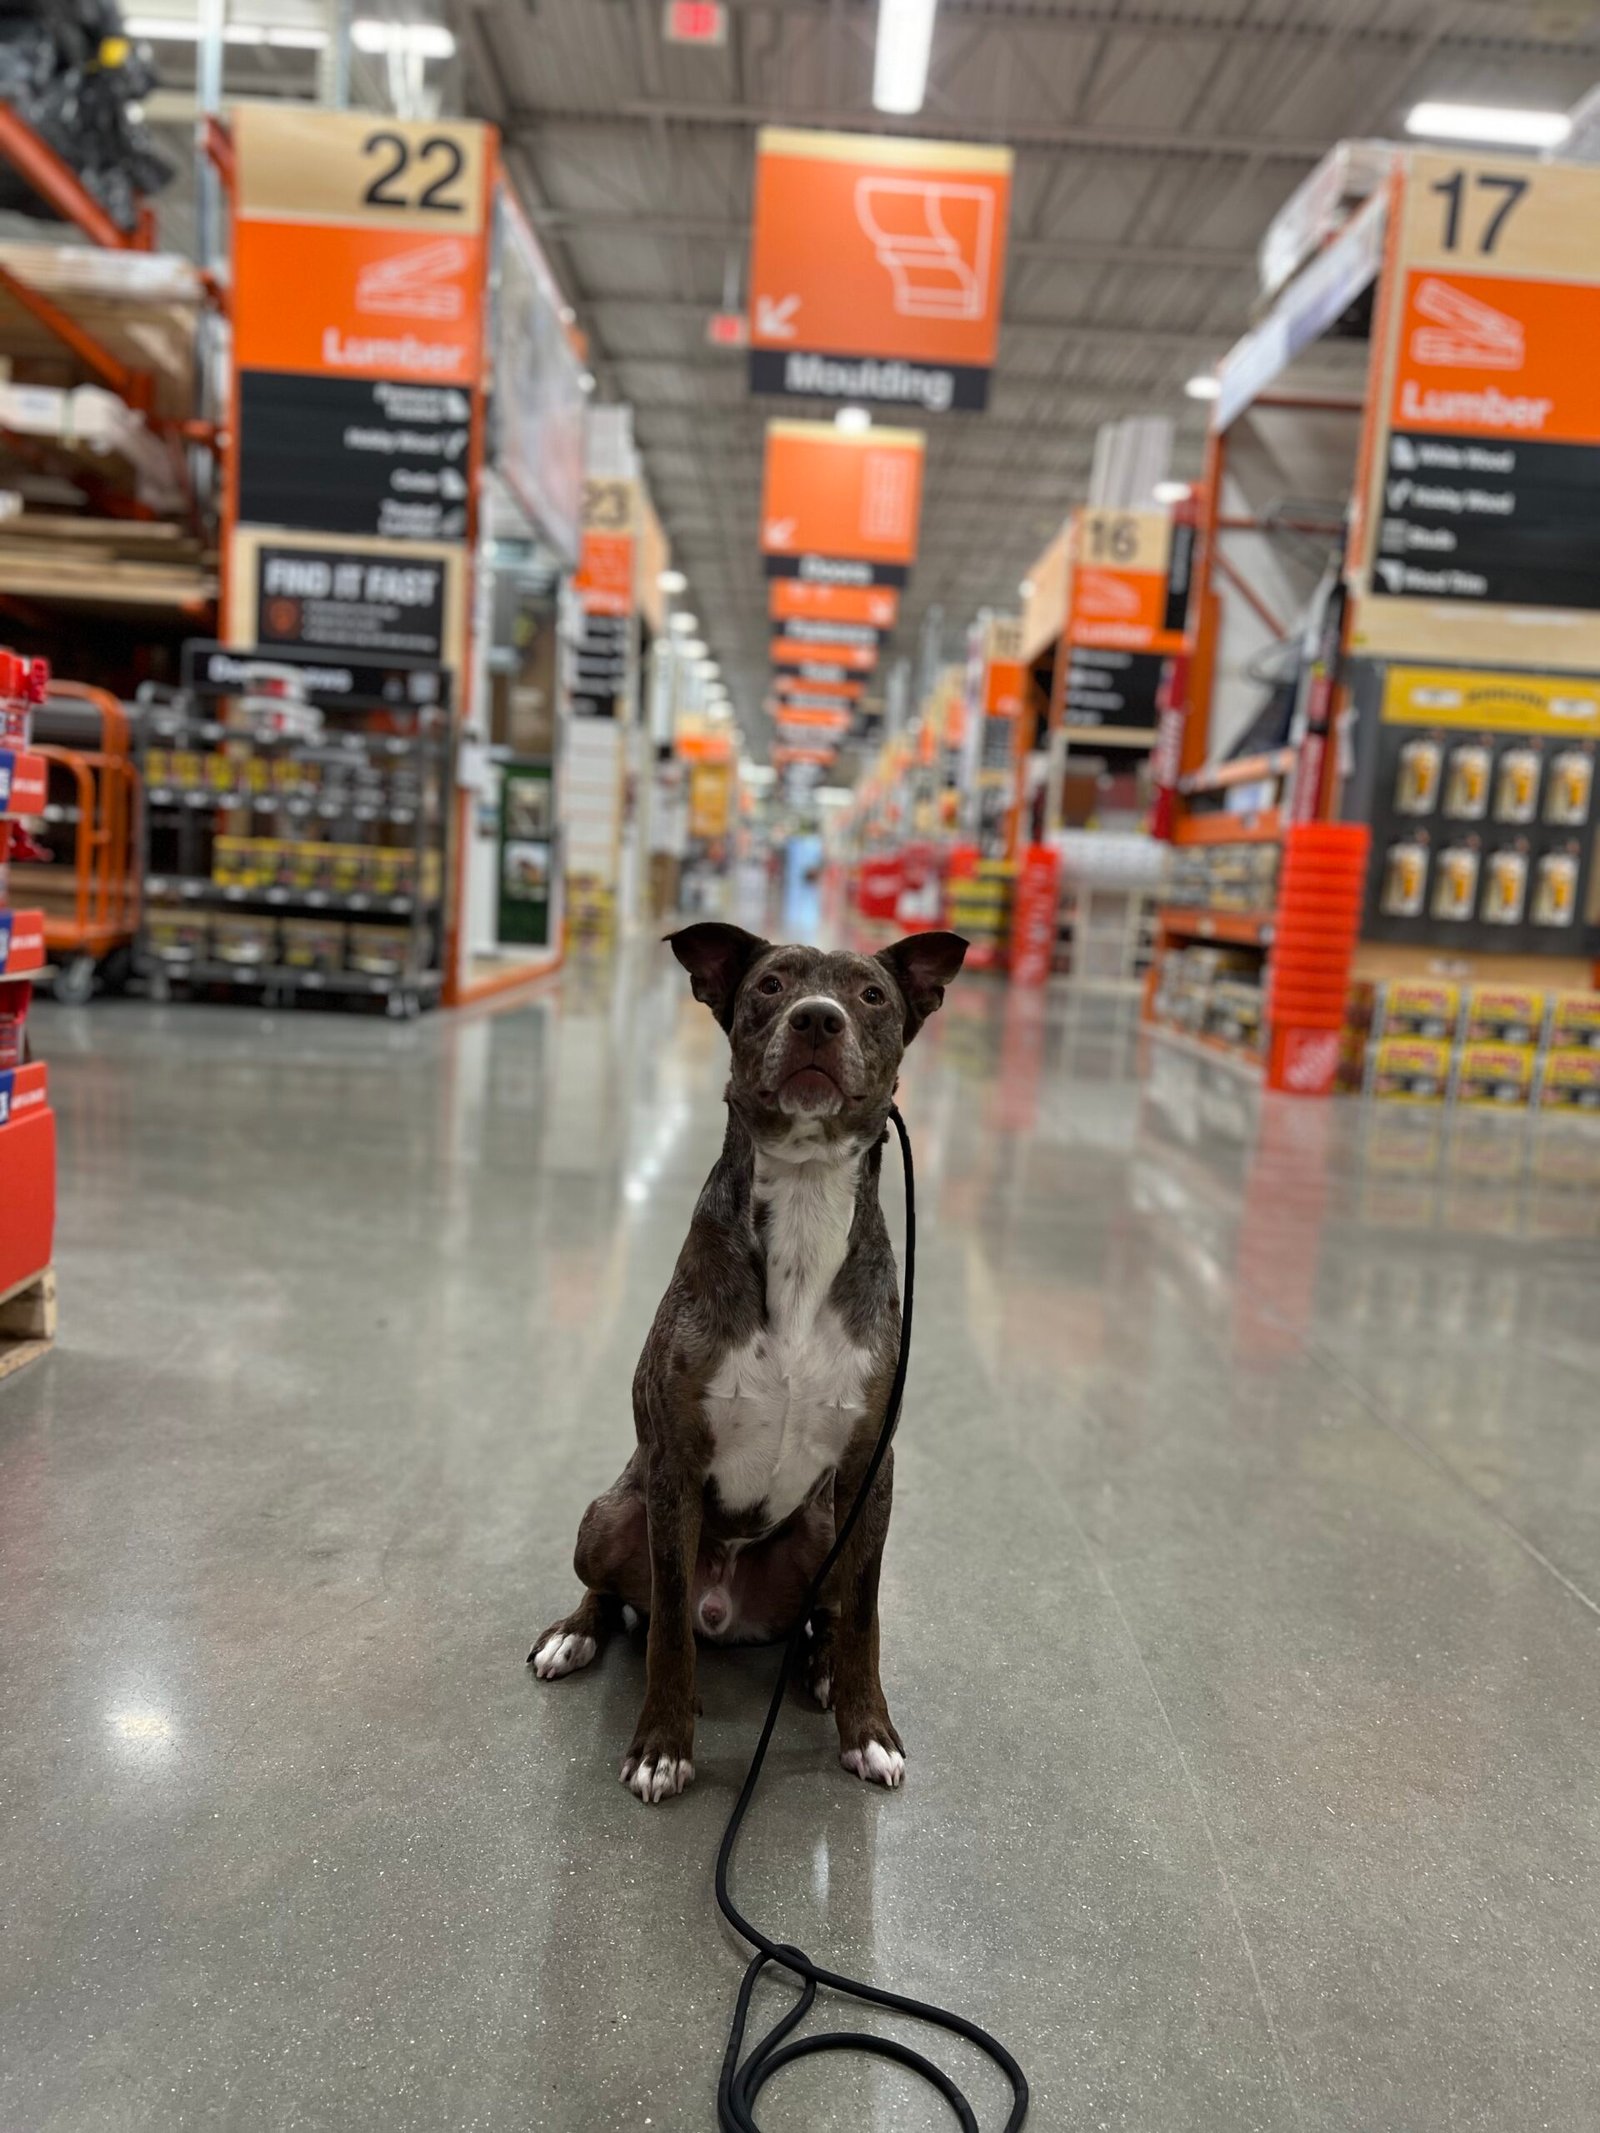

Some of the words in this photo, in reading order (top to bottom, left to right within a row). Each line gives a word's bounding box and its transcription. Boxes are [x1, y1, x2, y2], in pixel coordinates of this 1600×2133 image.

[362, 132, 465, 212] 22
[1431, 167, 1530, 254] 17
[323, 328, 464, 373] Lumber
[785, 355, 954, 410] Moulding
[1401, 381, 1552, 428] Lumber
[1090, 517, 1137, 560] 16
[264, 558, 331, 598] FIND
[333, 564, 364, 600] IT
[365, 566, 438, 606] FAST
